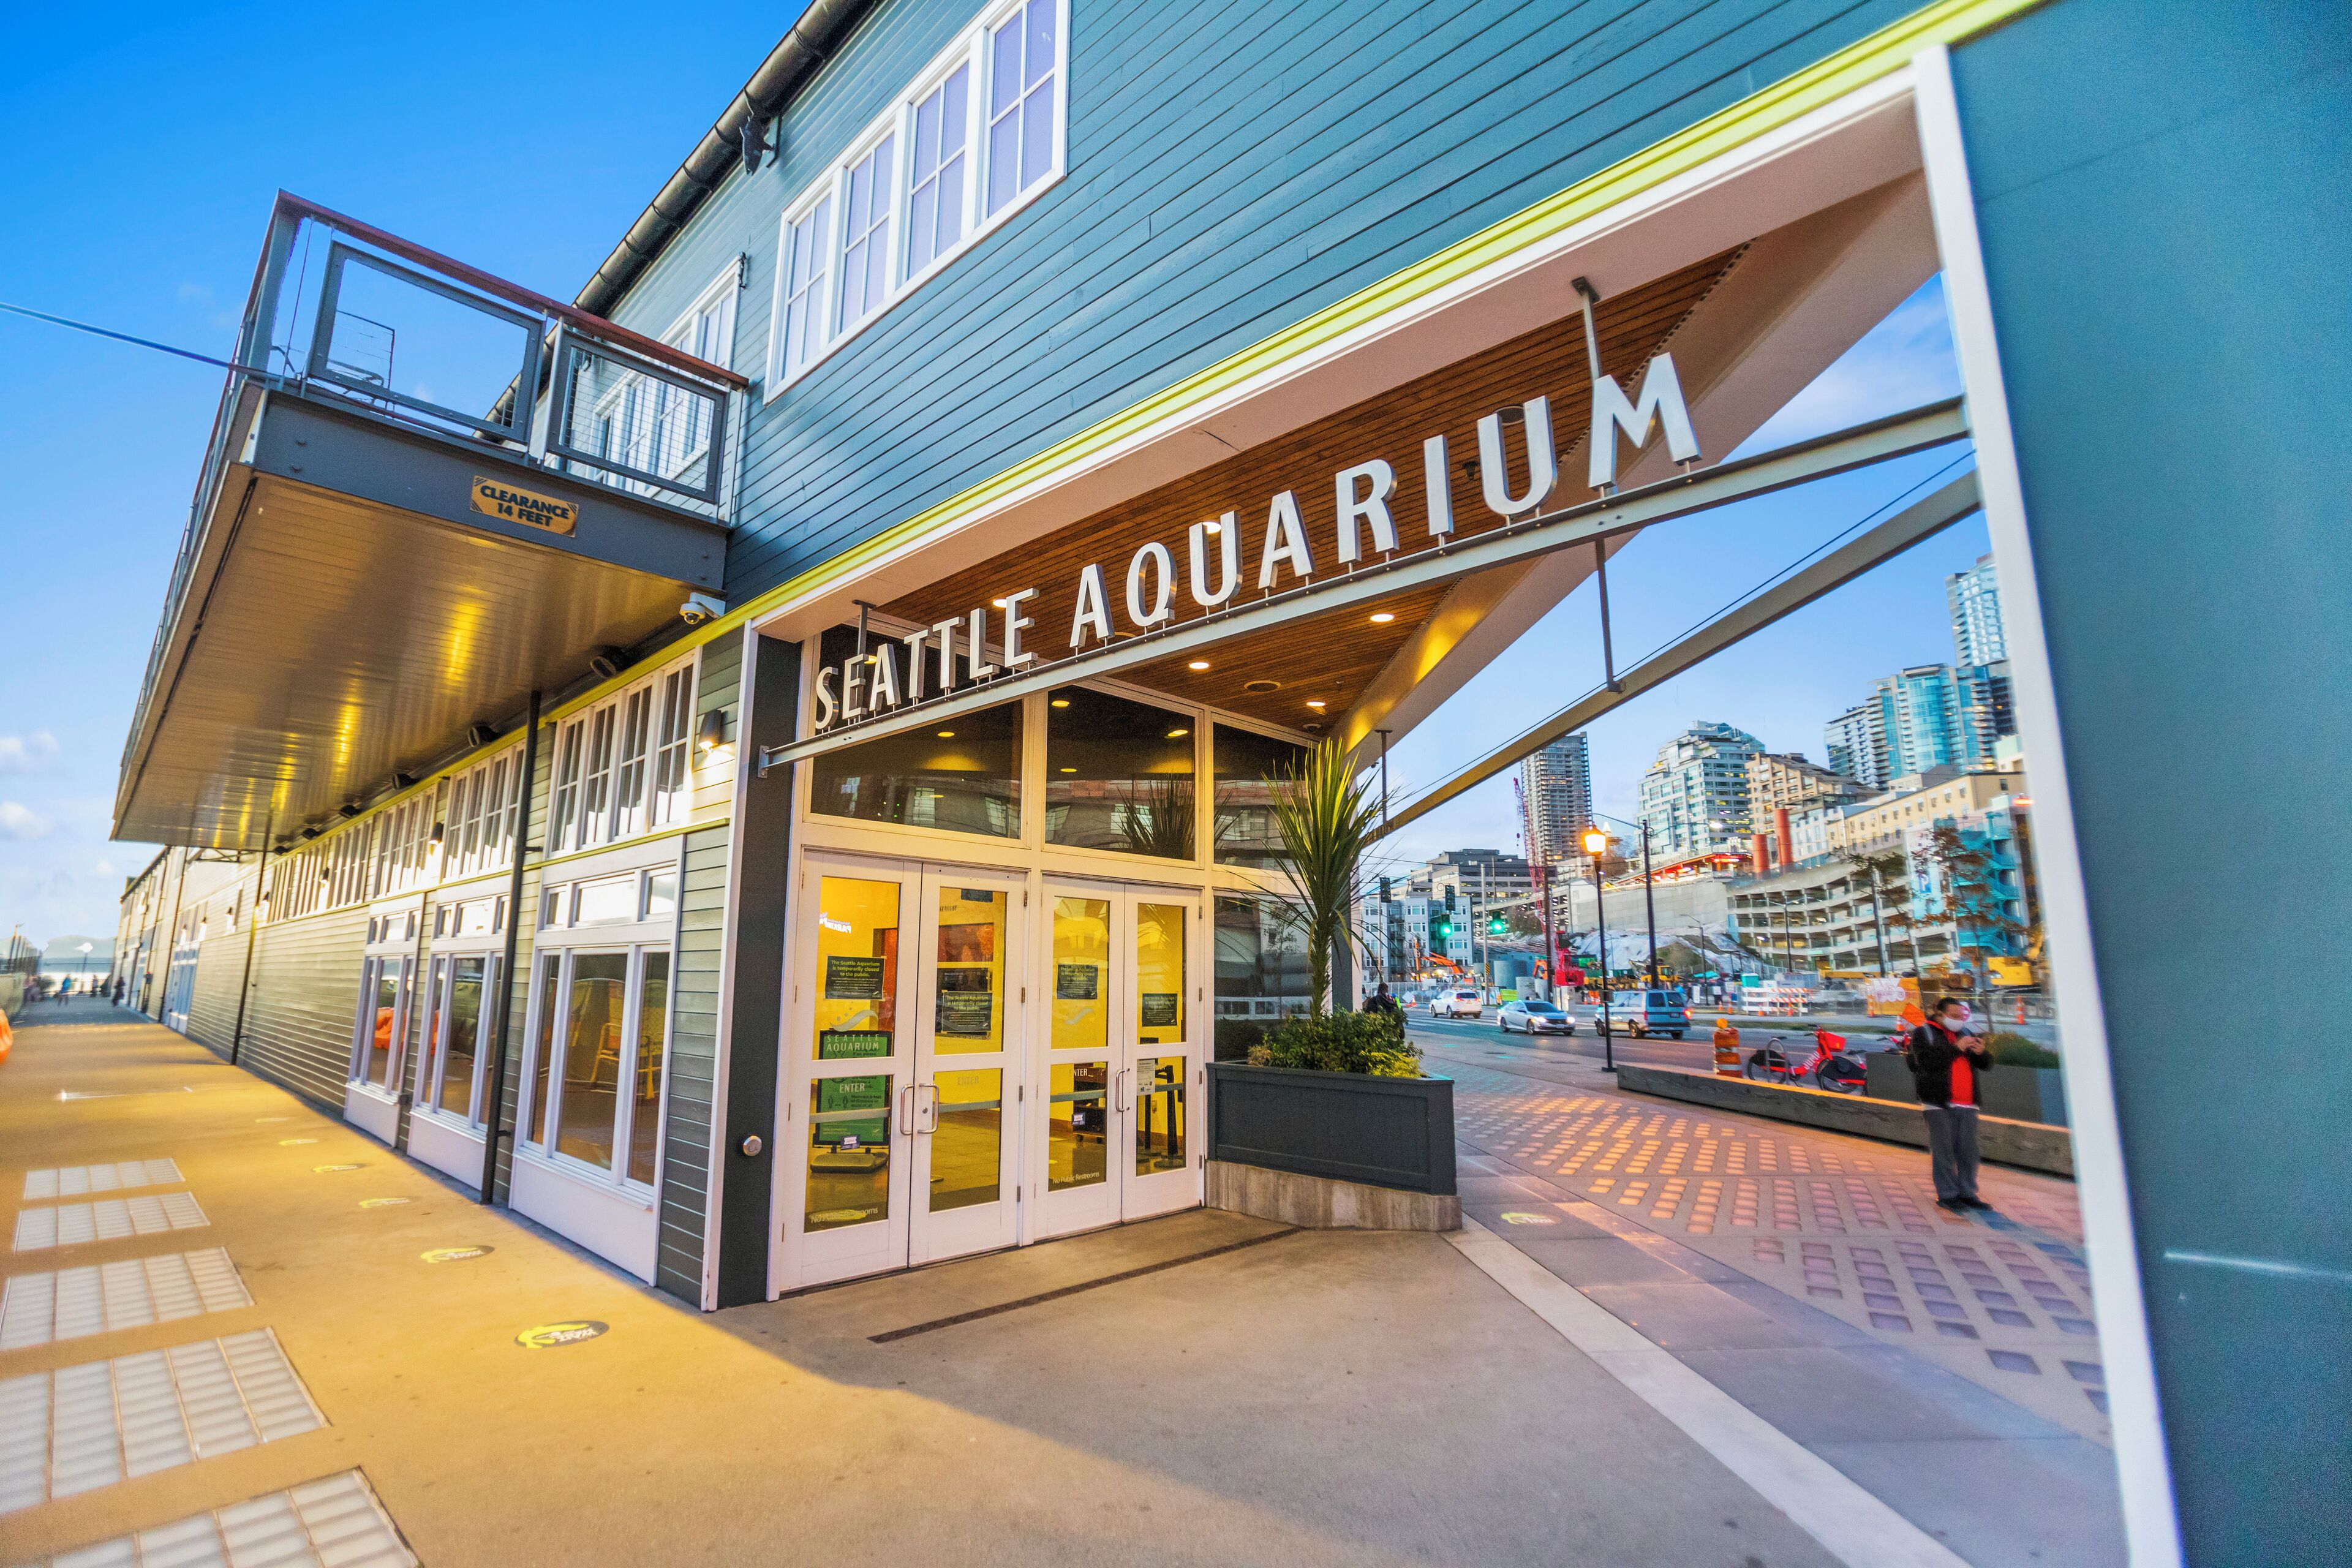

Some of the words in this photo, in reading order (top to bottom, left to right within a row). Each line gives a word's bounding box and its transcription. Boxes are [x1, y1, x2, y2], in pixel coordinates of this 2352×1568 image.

[480, 485, 570, 519] CLEARANCE
[497, 502, 513, 517] 14
[518, 507, 553, 527] FEET
[815, 587, 1039, 730] SEATTLE
[1069, 353, 1702, 648] AQUARIUM
[826, 1034, 879, 1042] SEATTLE
[826, 1042, 879, 1052] AQUARIUM
[1069, 1068, 1088, 1077] NTER
[839, 1083, 865, 1093] ENTER
[1060, 1175, 1075, 1183] Public
[1076, 1172, 1100, 1181] Restrooms
